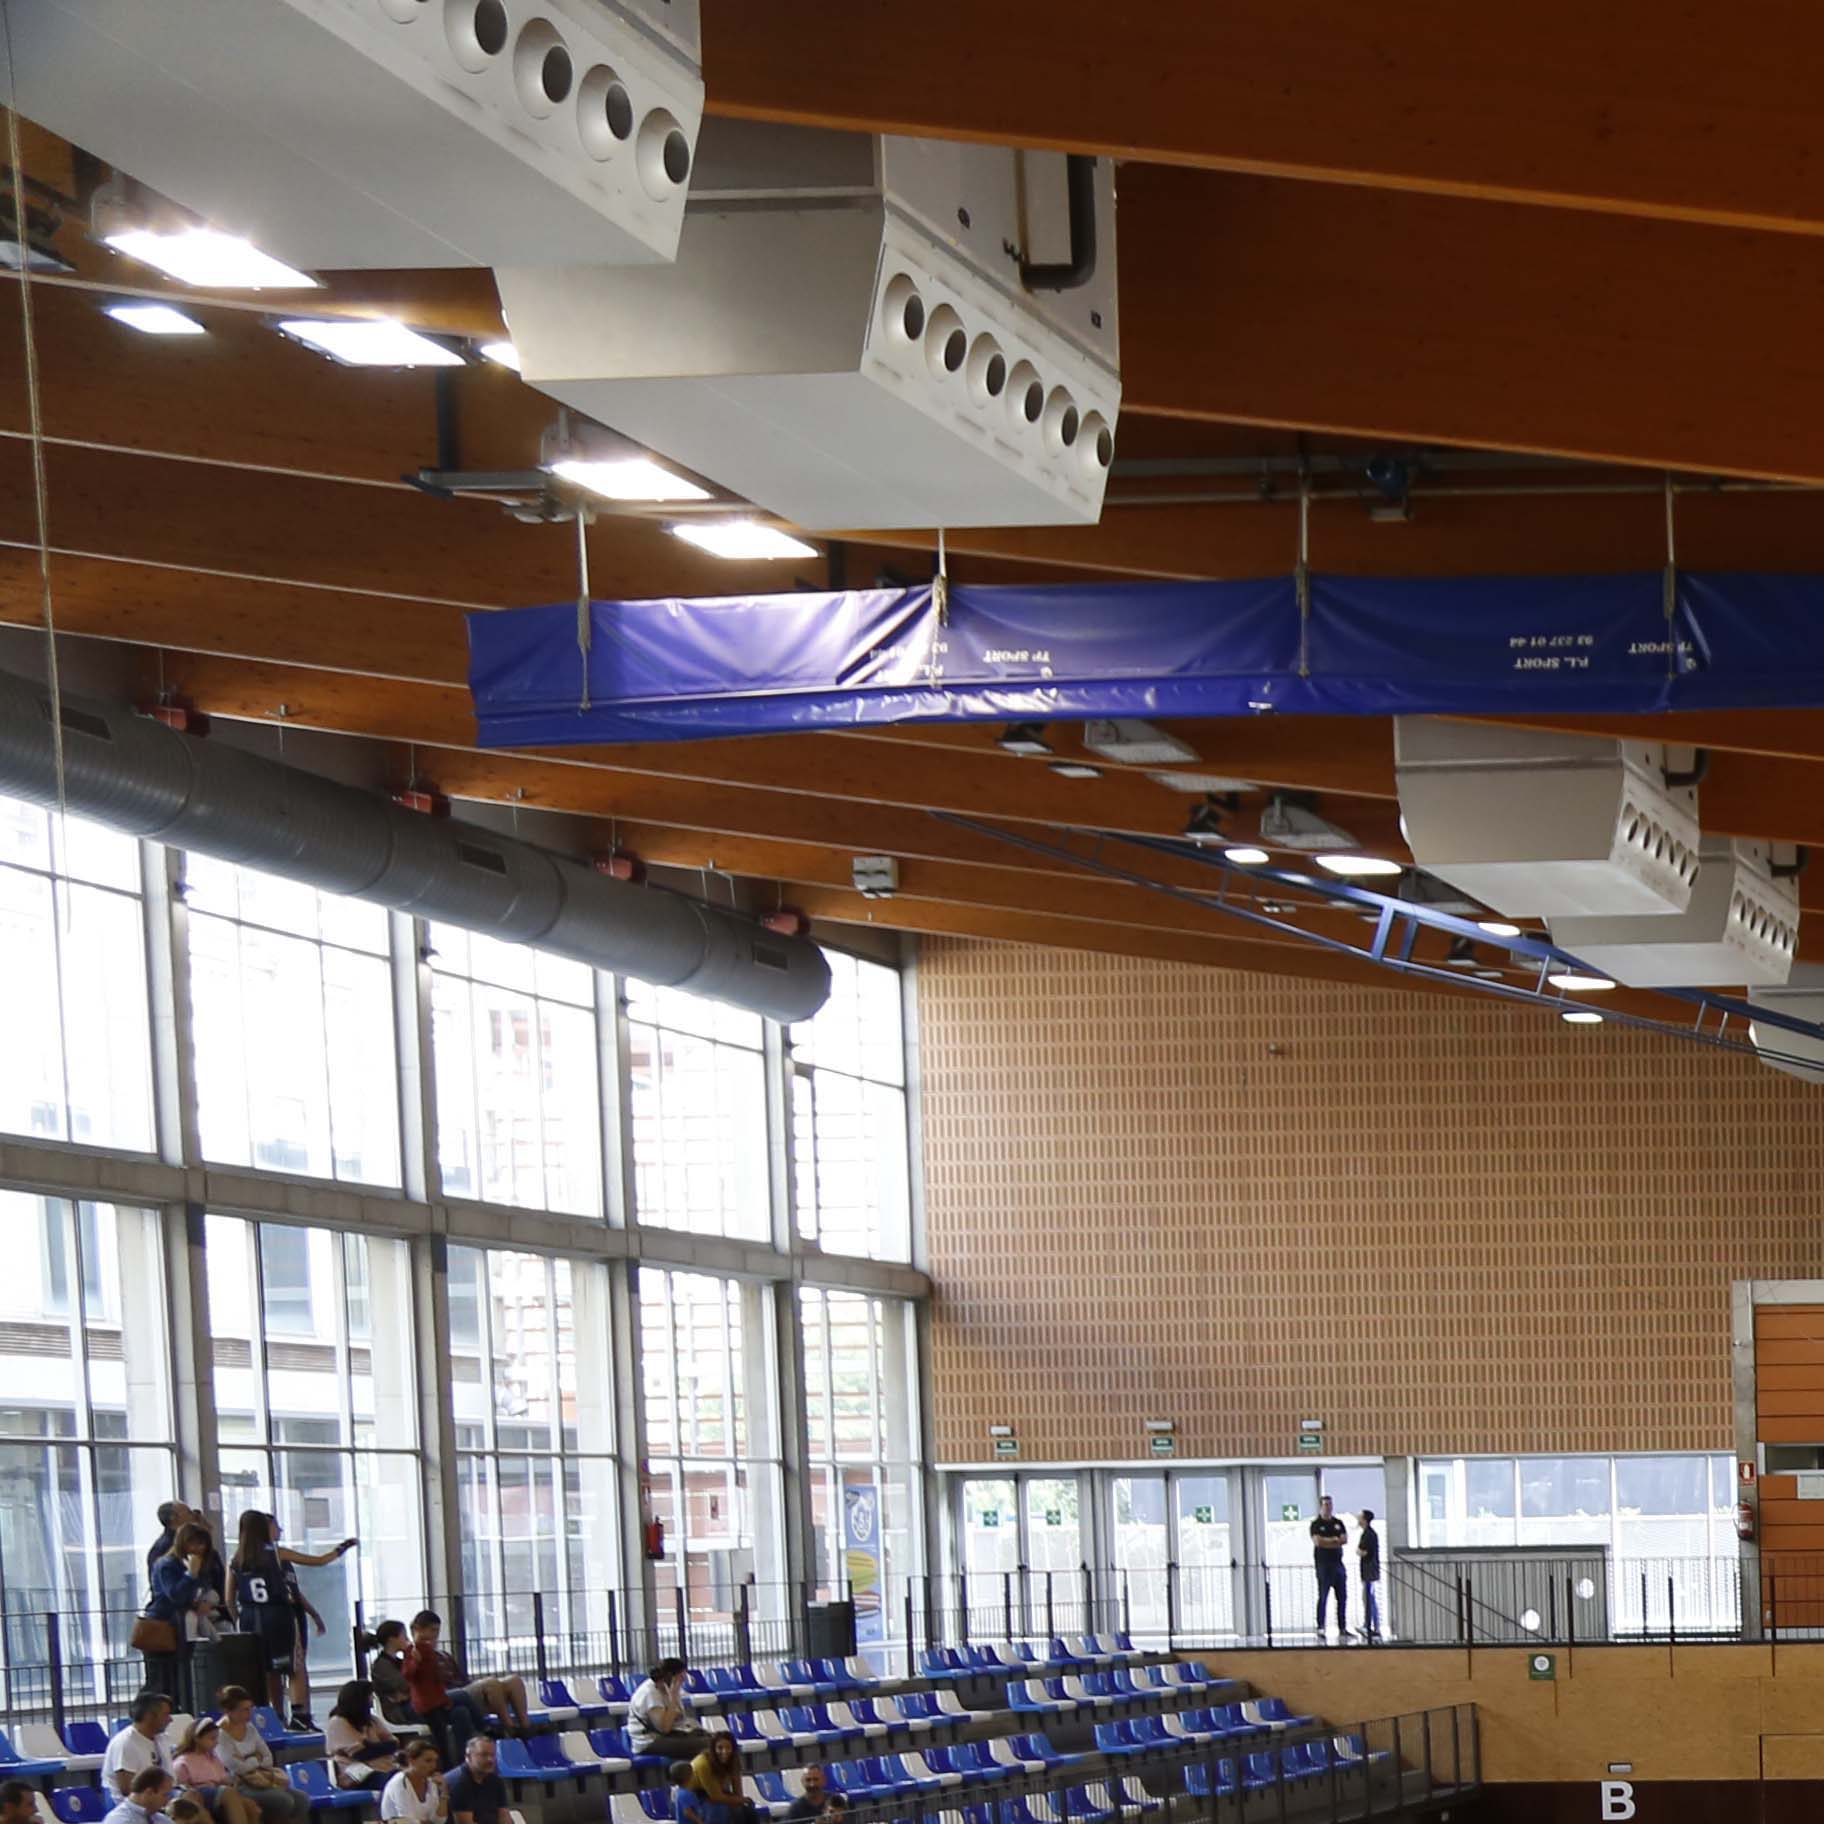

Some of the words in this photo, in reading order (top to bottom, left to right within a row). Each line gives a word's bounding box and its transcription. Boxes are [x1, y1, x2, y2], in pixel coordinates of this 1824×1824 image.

[1628, 642, 1675, 653] SPORT
[983, 650, 1029, 663] SPORT
[1513, 657, 1560, 669] SPORT
[250, 1577, 268, 1603] 6
[1601, 1782, 1636, 1821] B
